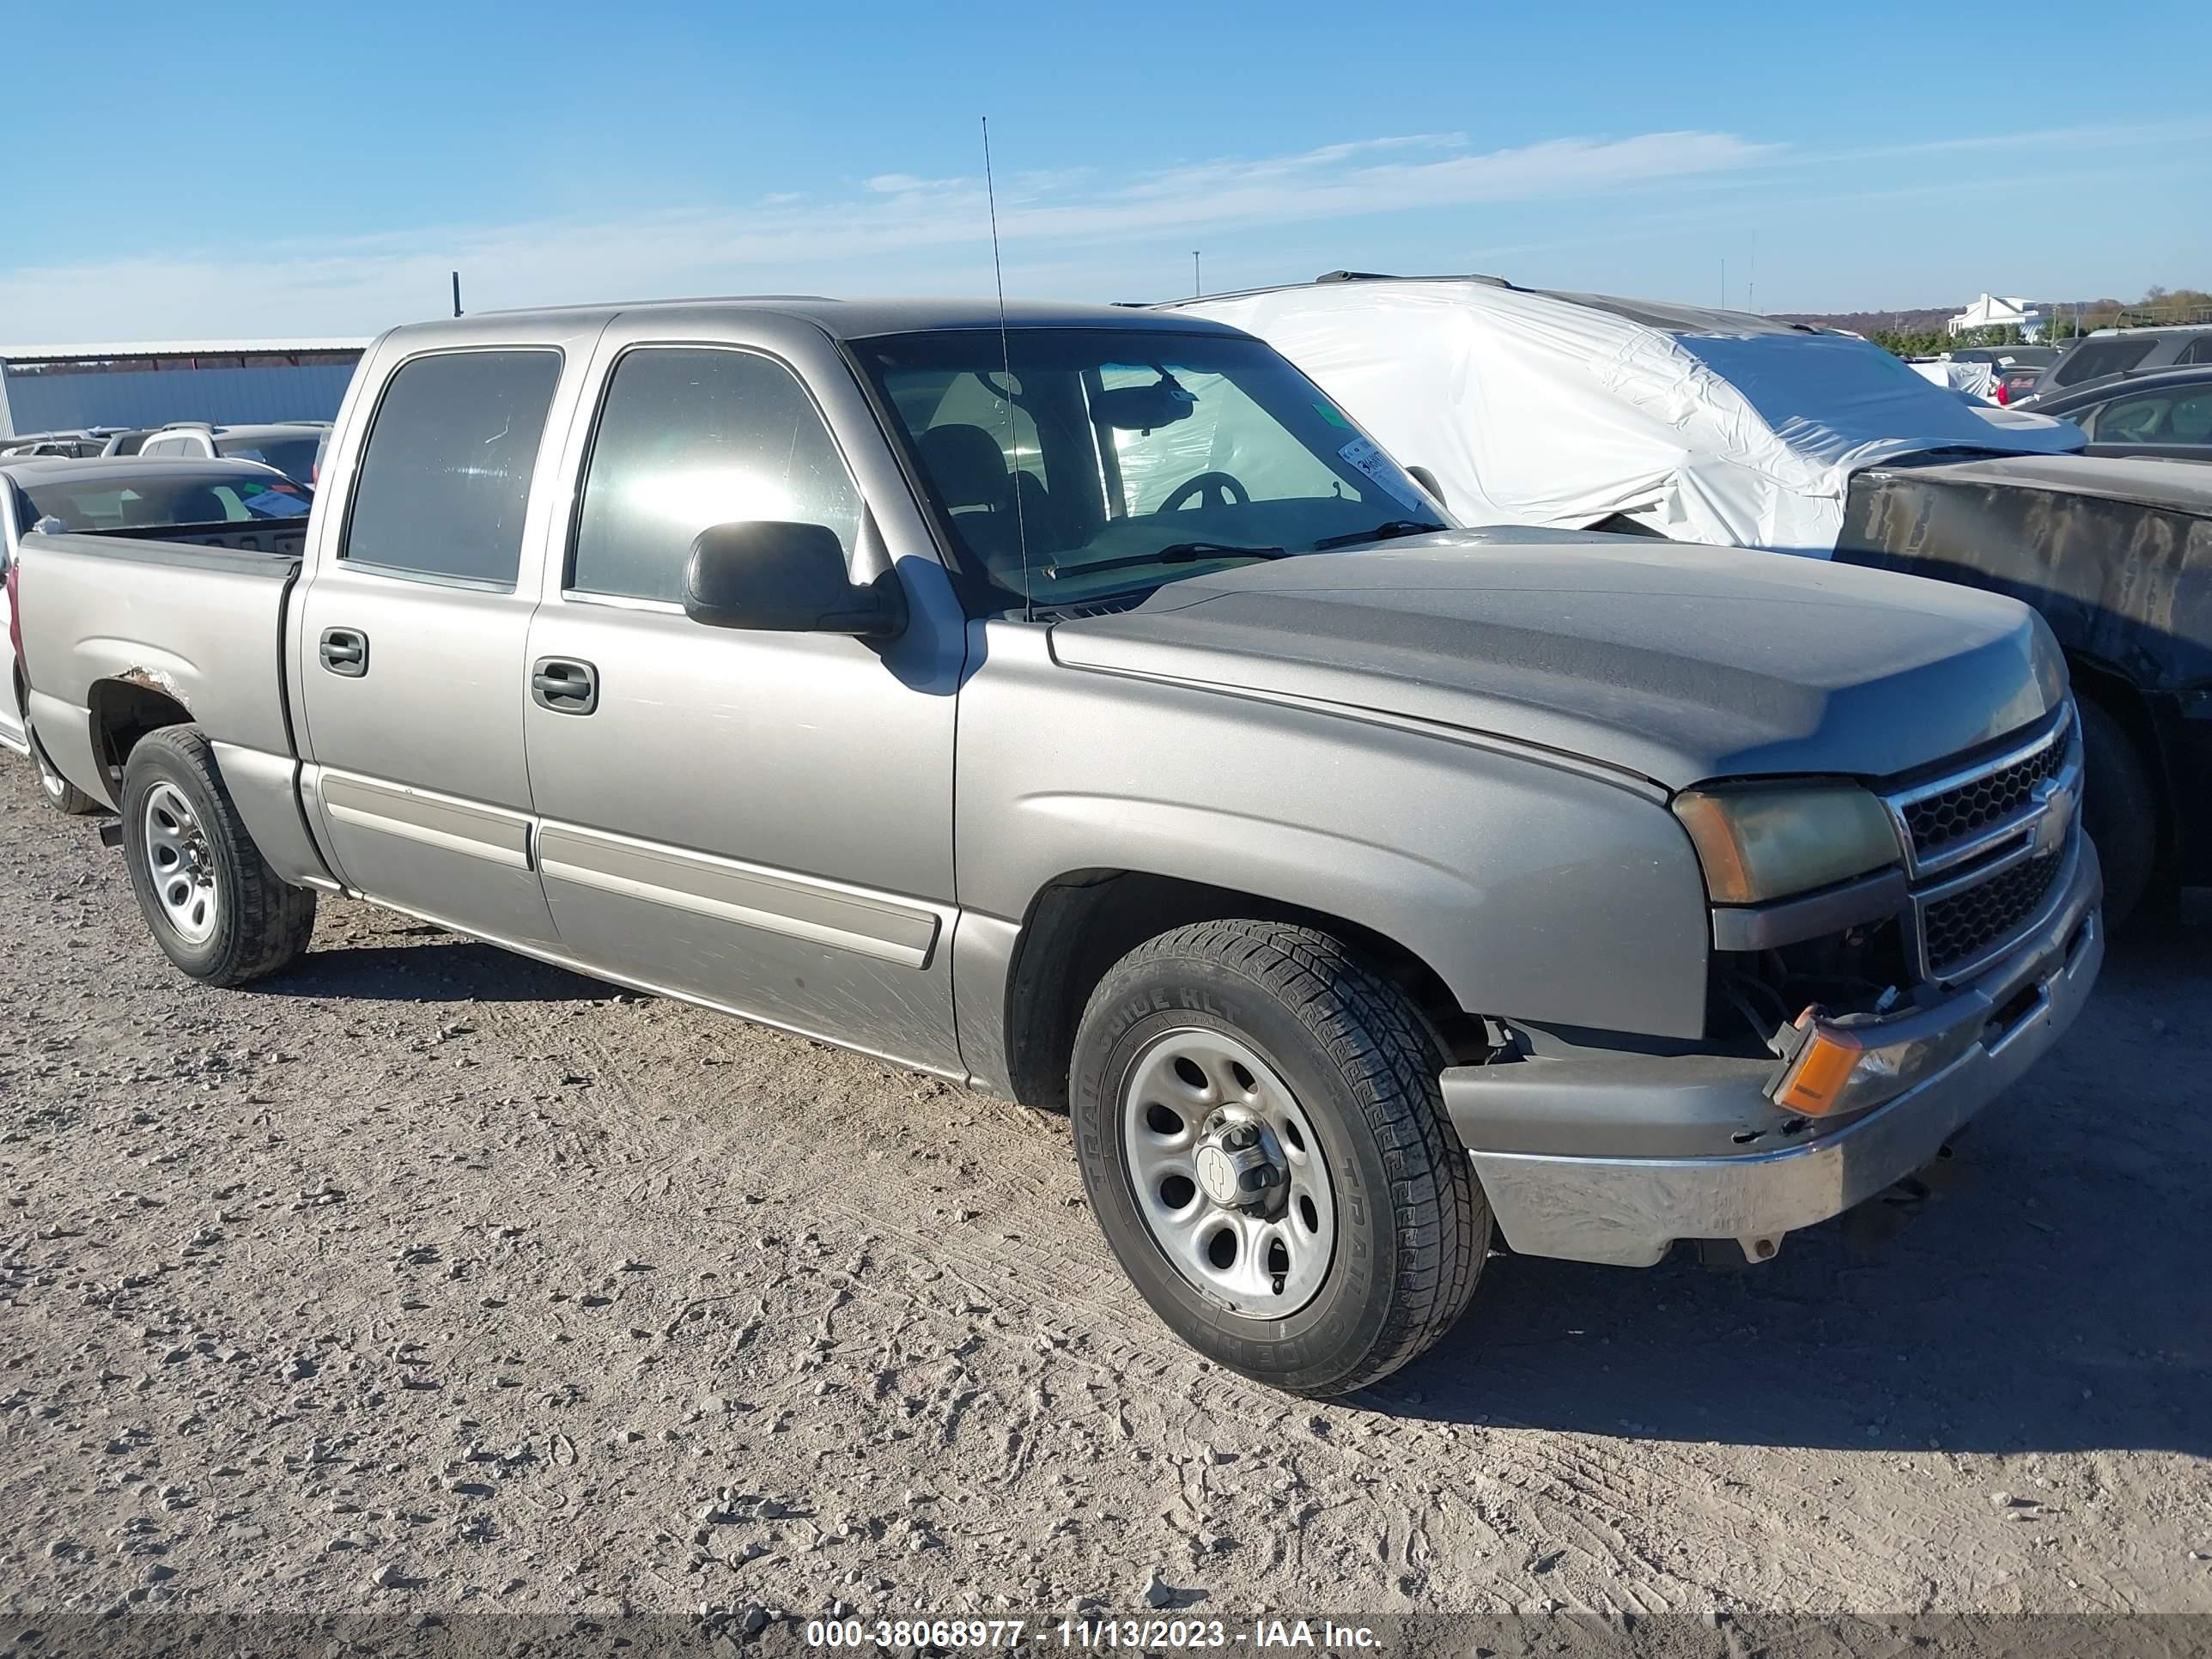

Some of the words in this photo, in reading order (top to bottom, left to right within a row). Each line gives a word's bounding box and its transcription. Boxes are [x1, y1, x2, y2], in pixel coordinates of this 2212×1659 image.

[1079, 1072, 1105, 1191] TRAIL
[1181, 988, 1243, 1023] HLT
[1340, 1158, 1366, 1297] TRAIL
